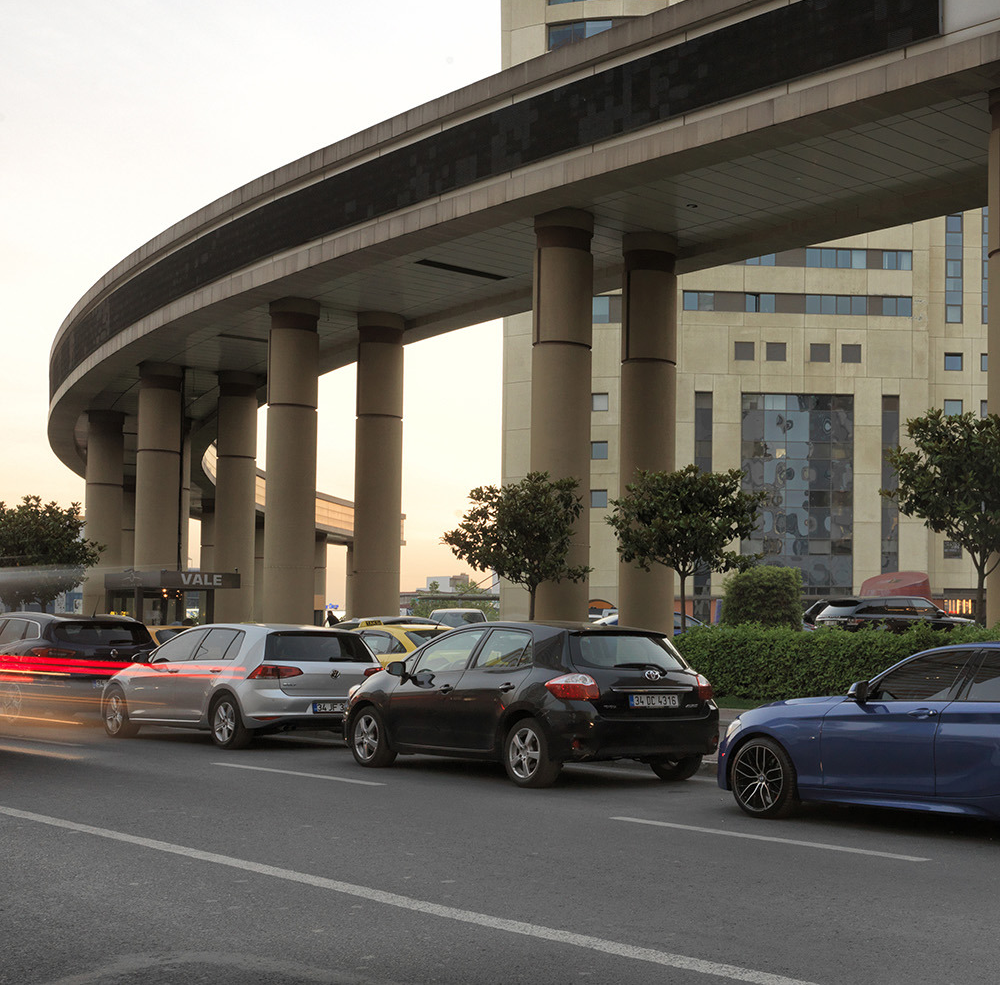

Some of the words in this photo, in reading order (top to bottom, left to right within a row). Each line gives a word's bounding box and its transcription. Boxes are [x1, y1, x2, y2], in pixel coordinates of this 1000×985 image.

[181, 573, 223, 586] VALE
[634, 695, 645, 706] 34
[657, 695, 677, 706] 4316
[317, 703, 326, 711] 34
[329, 703, 337, 711] JF
